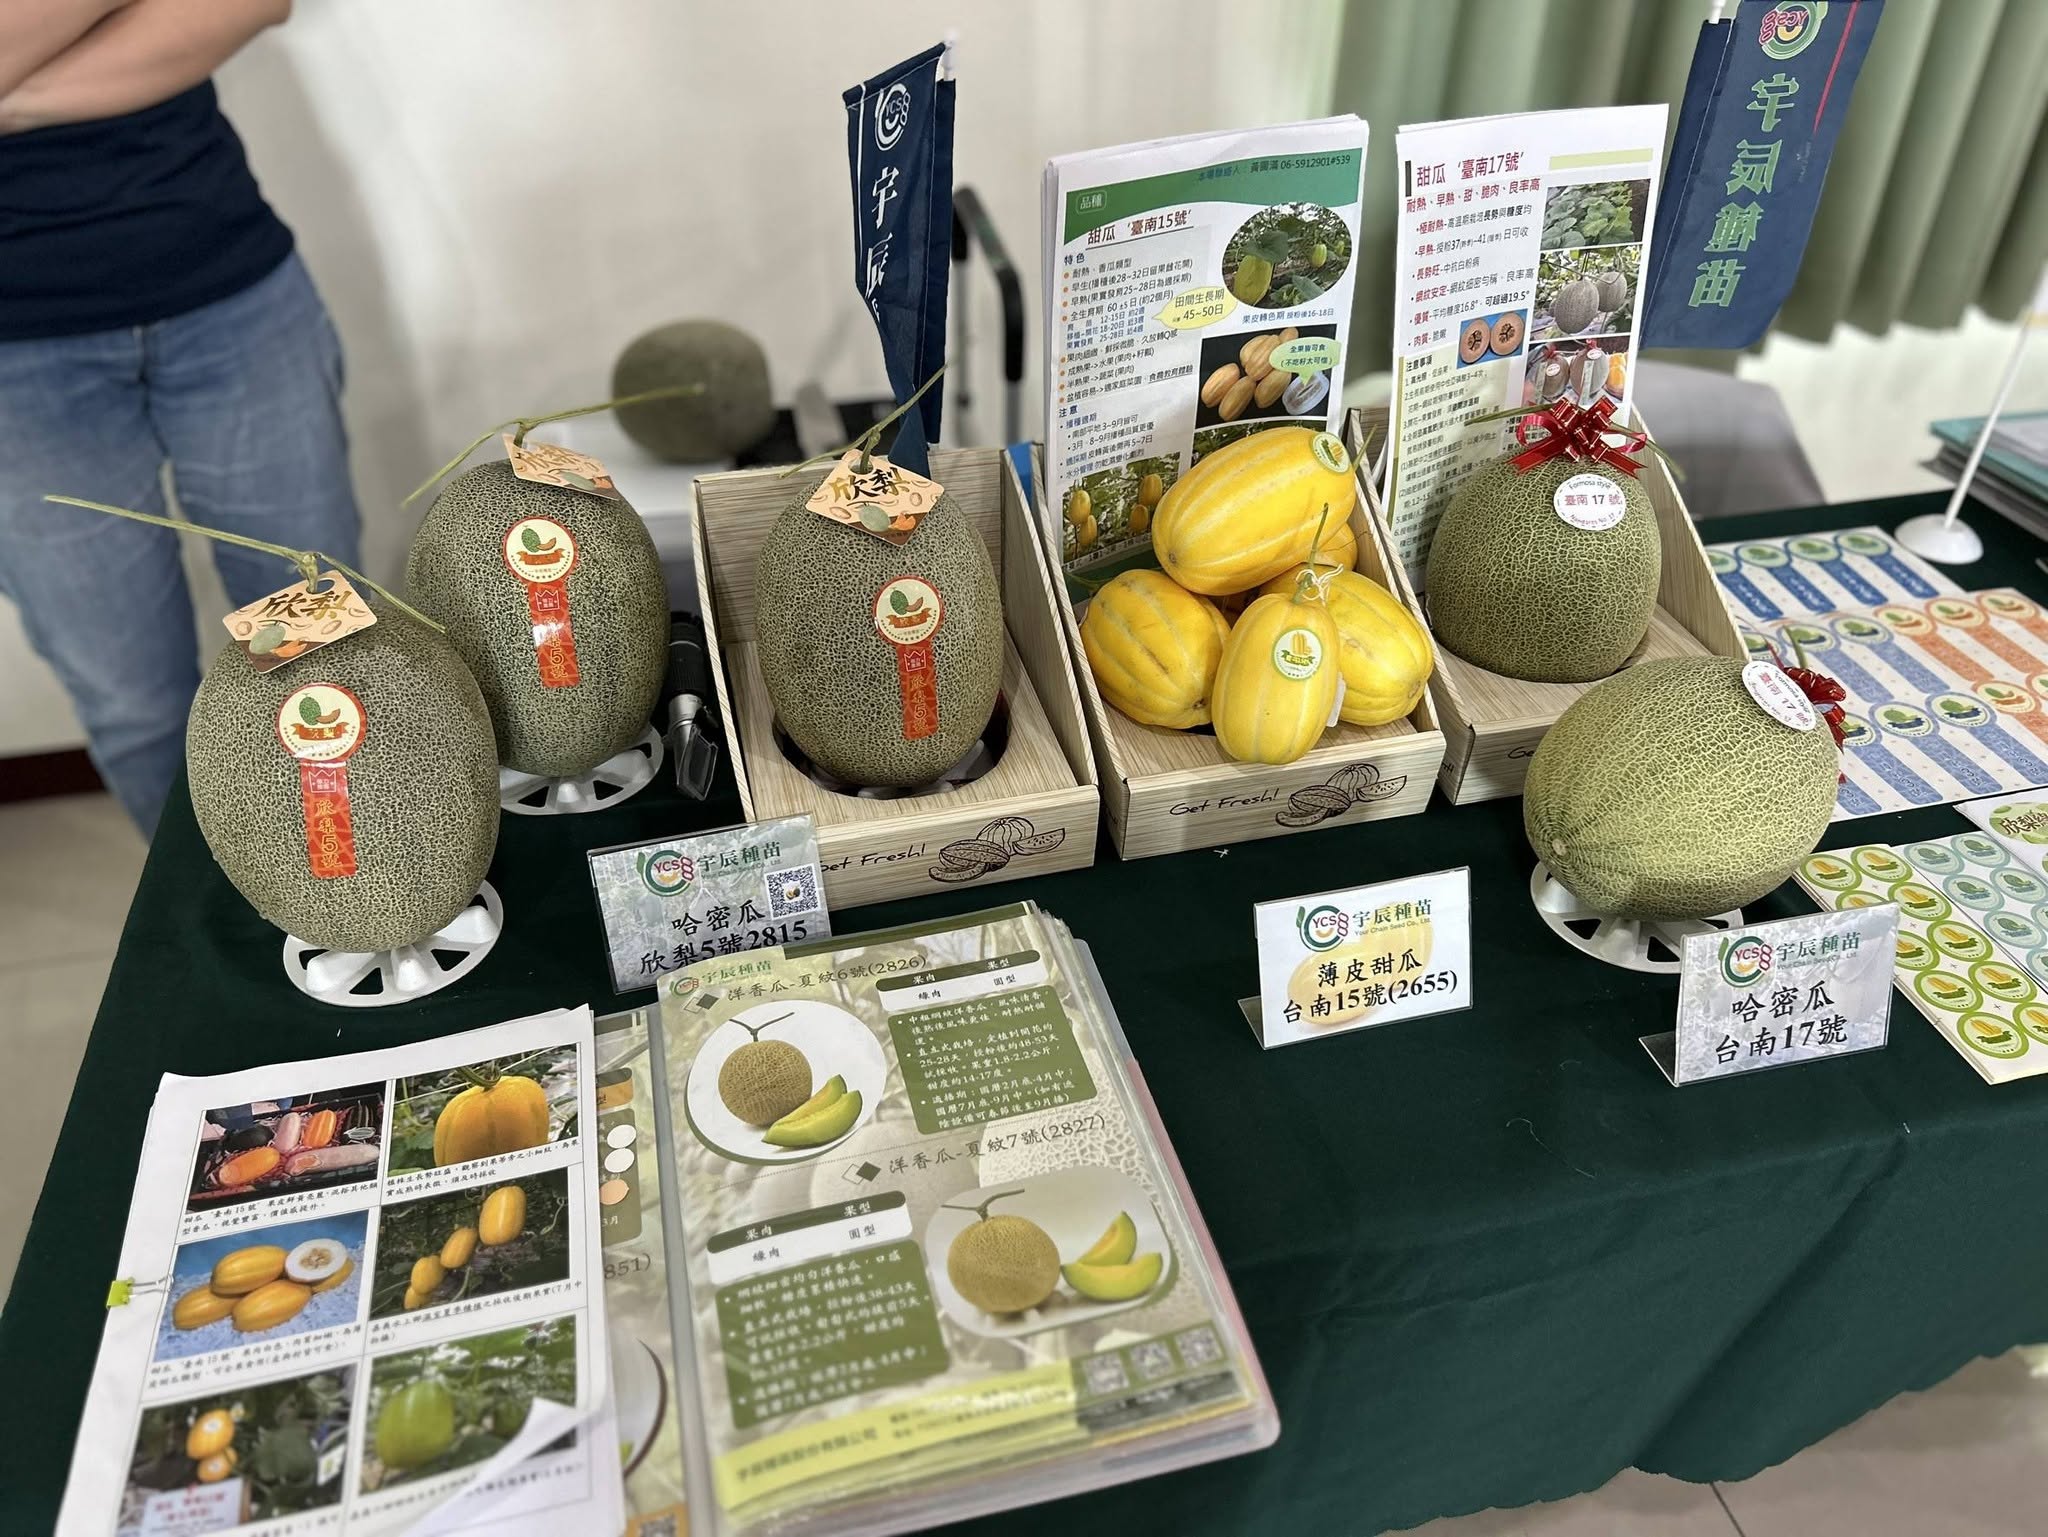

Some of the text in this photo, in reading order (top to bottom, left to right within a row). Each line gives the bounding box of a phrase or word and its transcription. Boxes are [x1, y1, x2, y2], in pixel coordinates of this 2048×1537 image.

[1280, 153, 1351, 171] 06-5912901#539
[1416, 163, 1447, 188] 甜瓜
[865, 167, 900, 322] 宇辰
[1088, 227, 1116, 246] 甜瓜
[1107, 303, 1118, 313] 60
[1175, 288, 1226, 309] 田間生長期
[1183, 304, 1224, 321] 45~50日
[828, 467, 911, 504] 欣梨
[1592, 494, 1605, 505] 17
[253, 590, 352, 621] 欣梨
[1508, 746, 1535, 759] Ge
[1169, 787, 1280, 817] Get Fresh!
[697, 841, 782, 873] 宇辰種苗
[820, 843, 926, 873] et Fresh!
[672, 898, 767, 937] 哈密瓜
[1352, 898, 1432, 928] 宇辰種苗
[1370, 925, 1390, 935] Chain
[1389, 922, 1406, 932] Seed
[1776, 931, 1862, 962] 宇辰種苗
[701, 959, 773, 985] 宇辰種苗
[727, 954, 928, 1002] 洋香瓜-夏紋6號(2826)
[1317, 948, 1423, 988] 薄皮甜瓜
[1282, 969, 1459, 1024] 台南15號(2655)
[1732, 979, 1835, 1024] 哈密瓜
[1715, 1014, 1849, 1066] 台南17號
[888, 1113, 1106, 1175] 洋香瓜-夏紋7號(2827)
[602, 1253, 651, 1281] 851)
